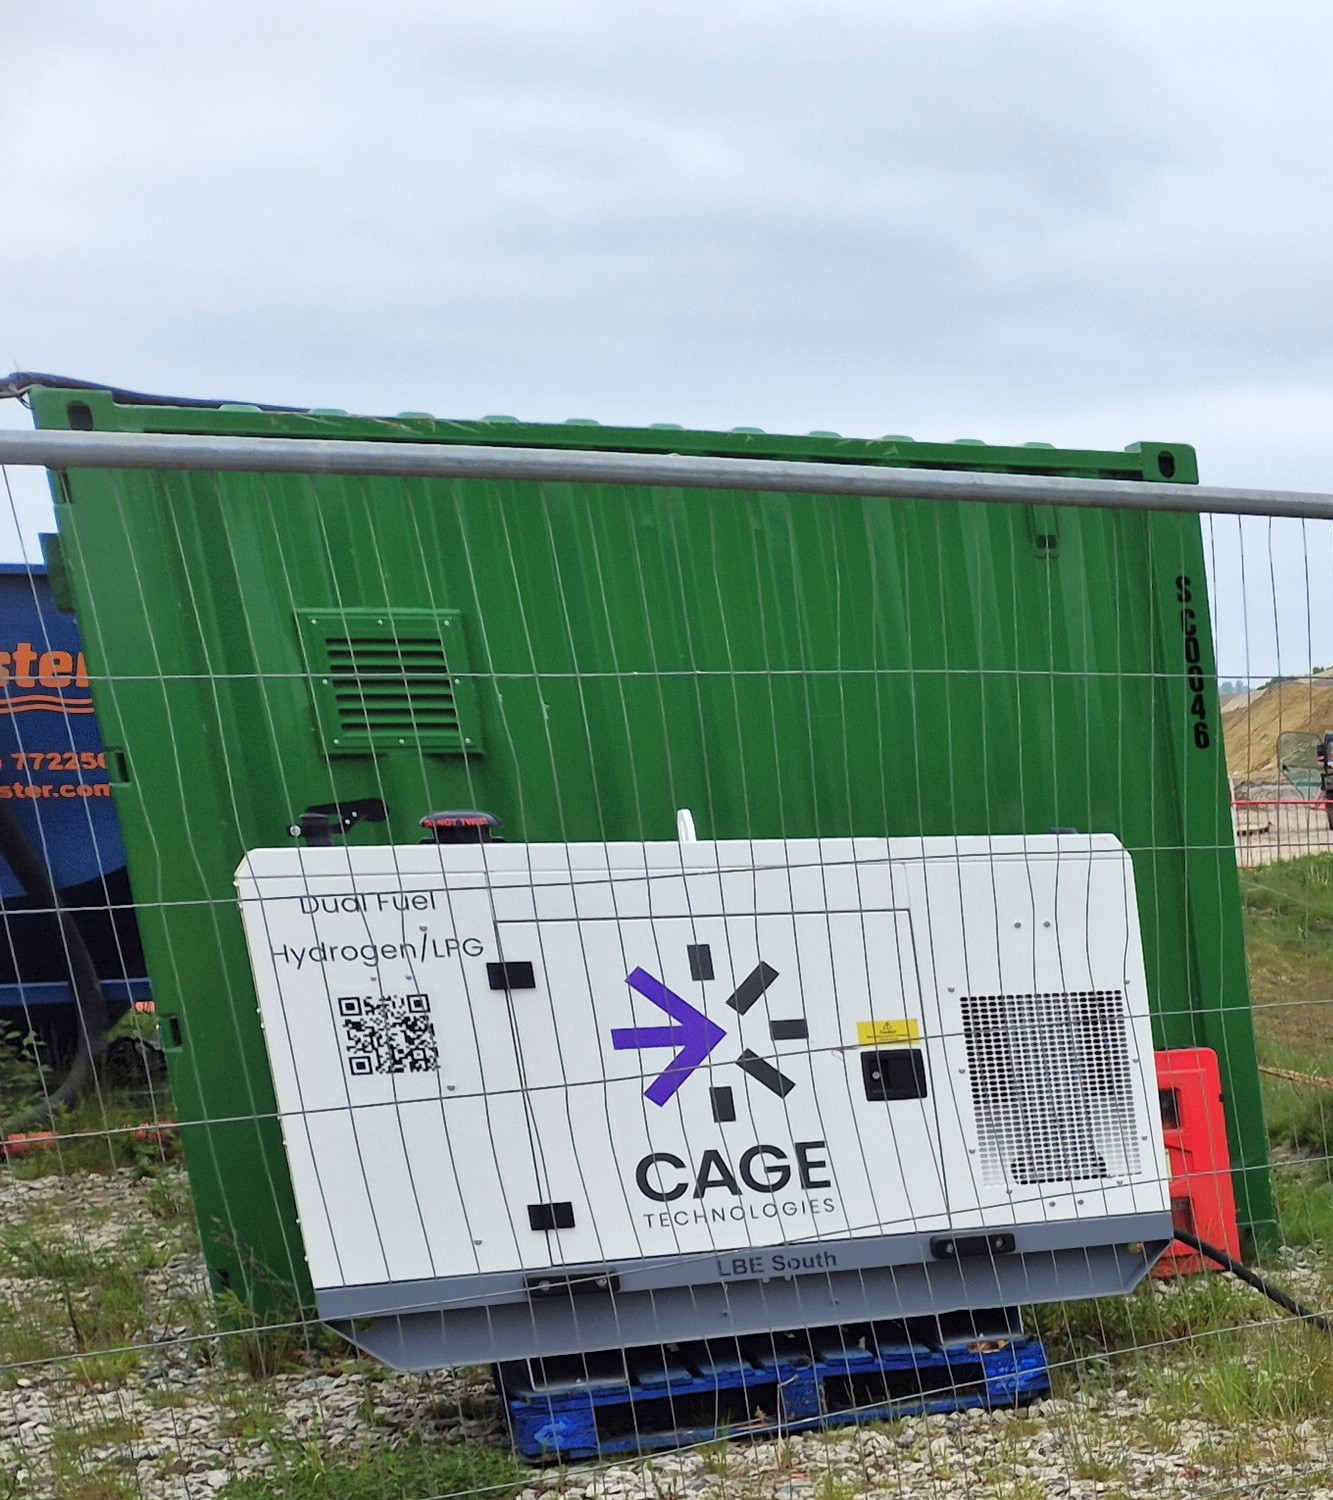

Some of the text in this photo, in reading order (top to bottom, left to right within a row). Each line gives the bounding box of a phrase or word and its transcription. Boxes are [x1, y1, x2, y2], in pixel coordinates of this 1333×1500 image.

[300, 890, 436, 914] Dual Fuel
[272, 932, 484, 970] Hydrogen/LPG
[635, 1141, 832, 1202] CAGE
[643, 1198, 835, 1228] TECHNOLOGIES
[717, 1251, 837, 1277] LBE South
